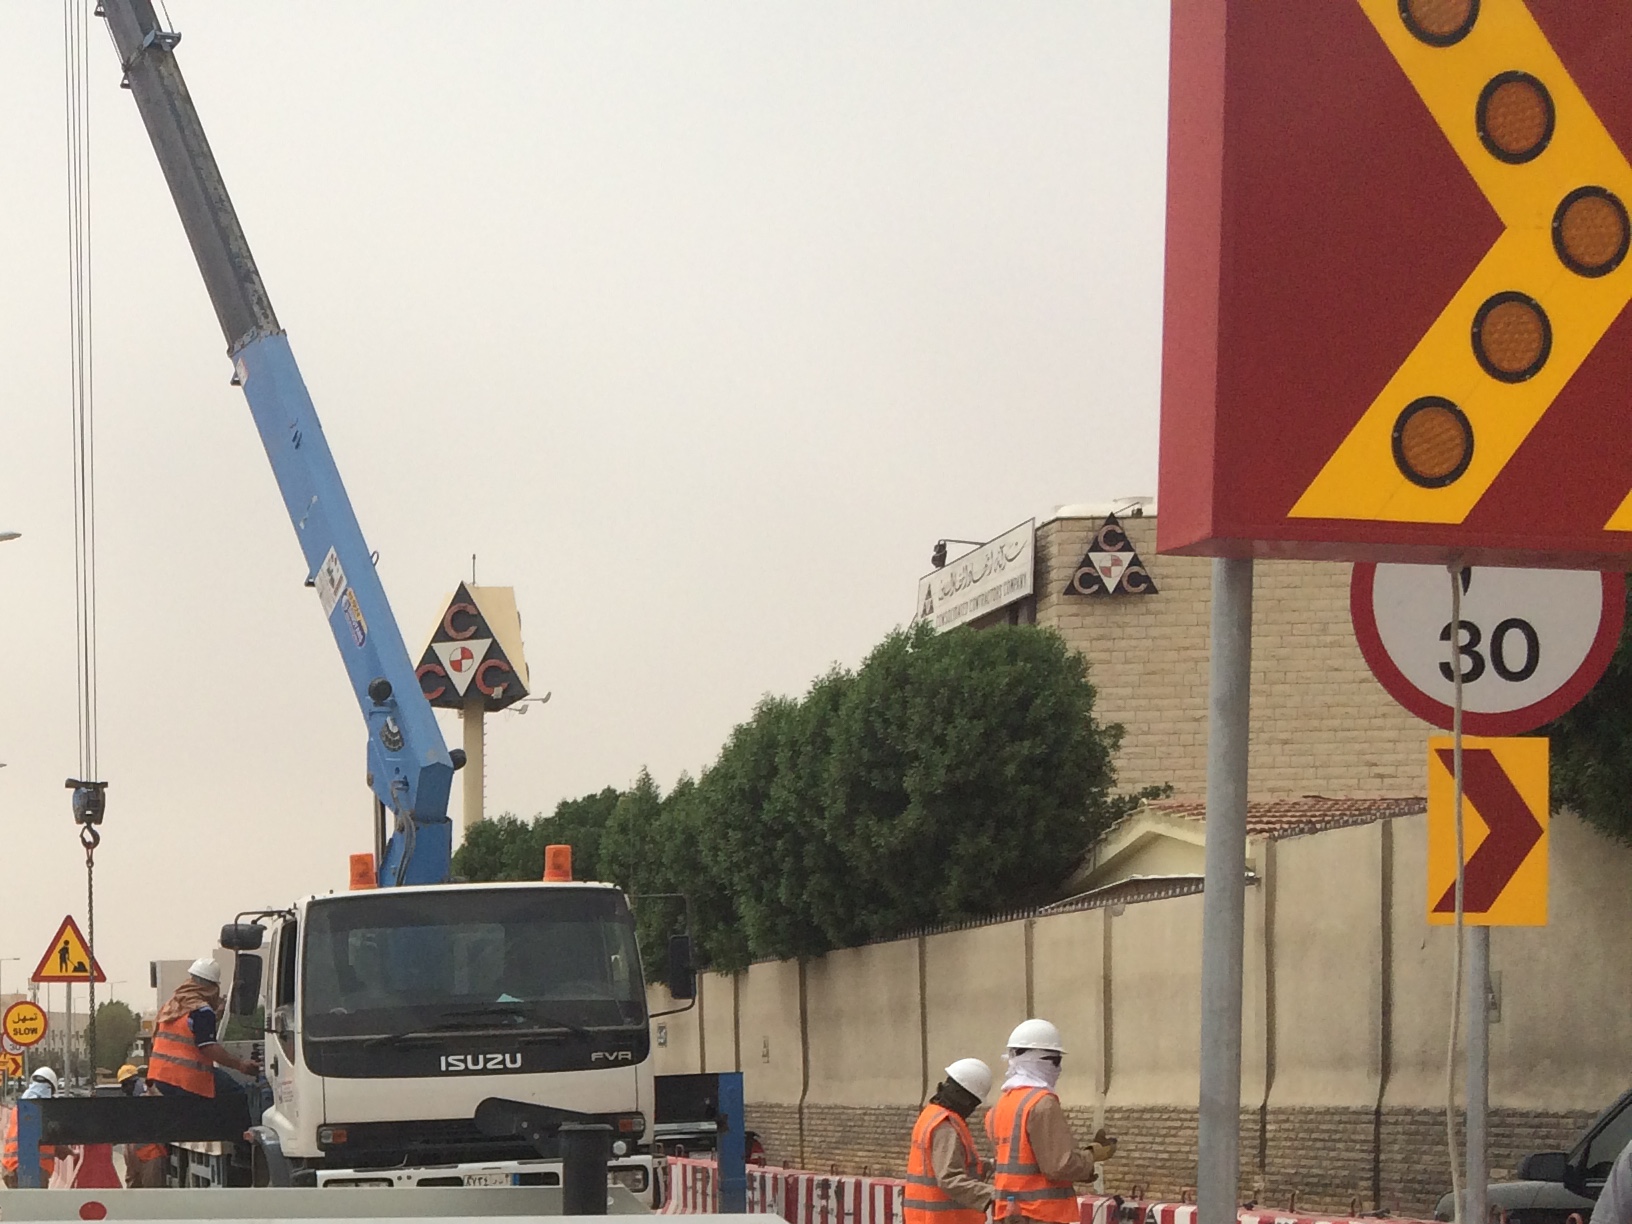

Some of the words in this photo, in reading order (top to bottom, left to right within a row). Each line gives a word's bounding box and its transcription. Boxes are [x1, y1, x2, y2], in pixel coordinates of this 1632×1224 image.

[1003, 572, 1027, 597] COMPANY
[1438, 617, 1540, 684] 30
[12, 1013, 37, 1024] تمهل
[13, 1027, 38, 1036] SLOW
[440, 1053, 522, 1072] ISUZU
[591, 1051, 632, 1062] FVR
